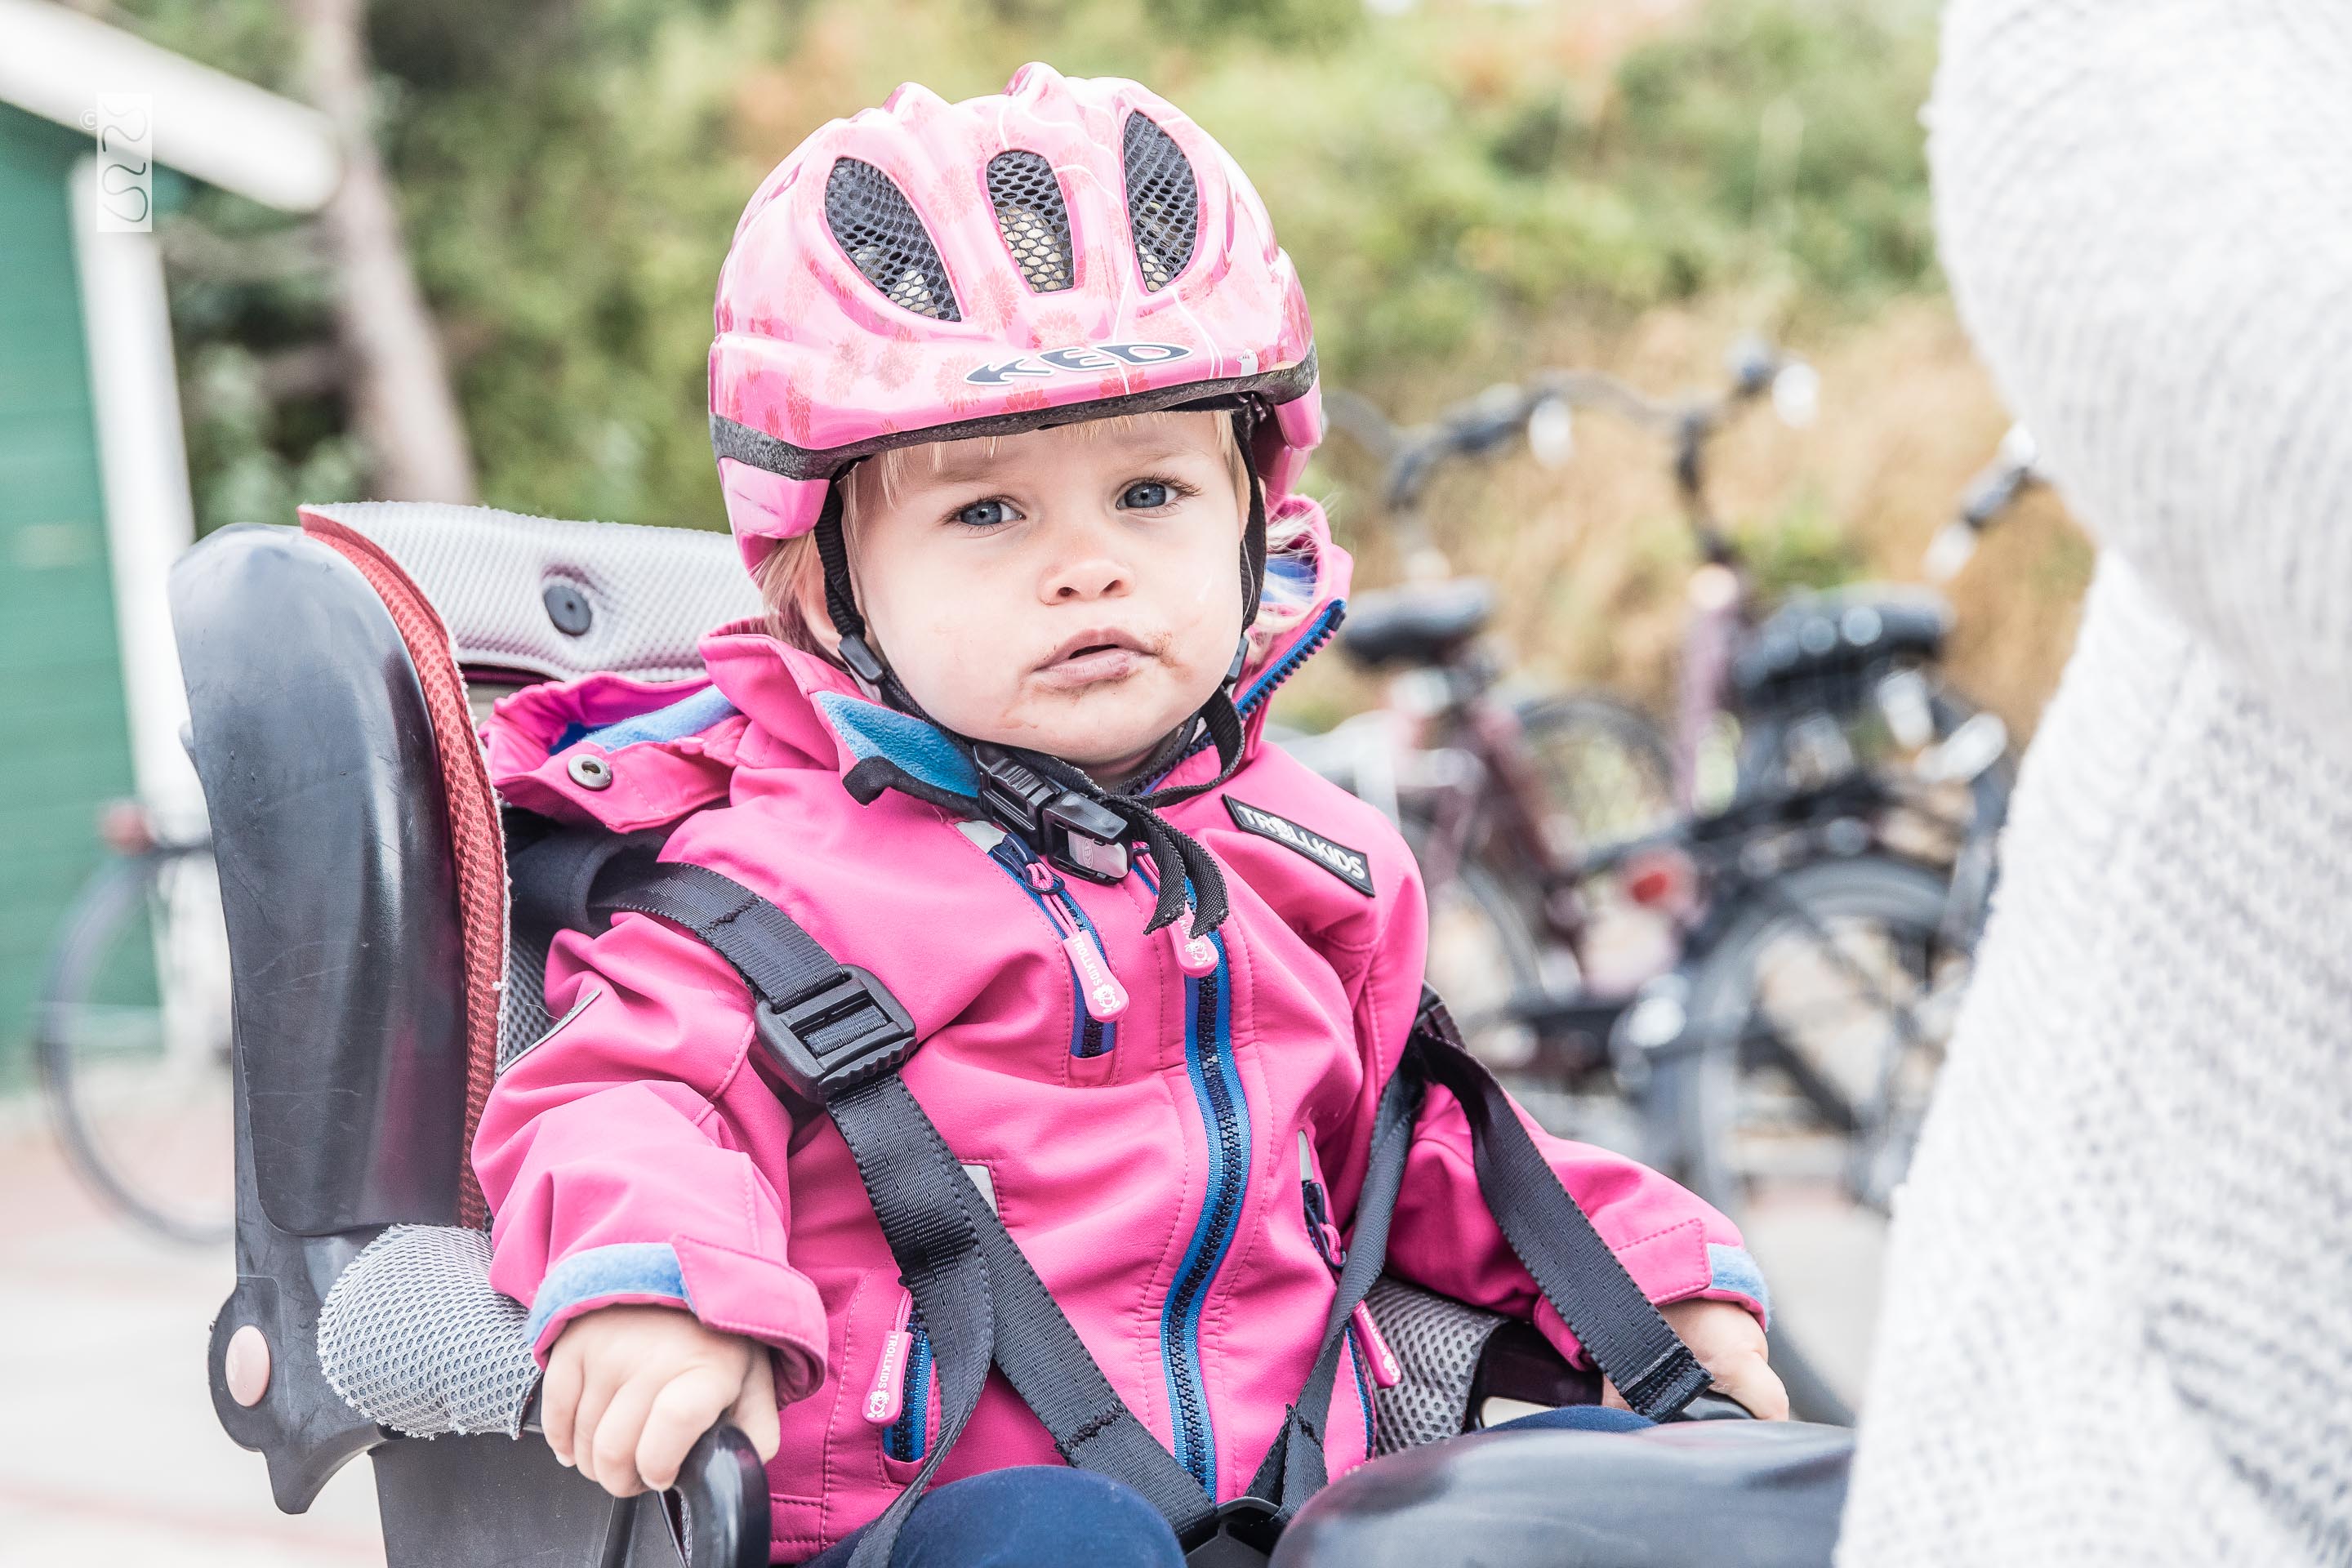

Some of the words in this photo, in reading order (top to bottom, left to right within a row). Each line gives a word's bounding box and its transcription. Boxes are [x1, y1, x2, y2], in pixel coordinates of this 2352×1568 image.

[963, 343, 1192, 384] KED
[1236, 804, 1365, 880] TROLLKIDS
[1071, 934, 1102, 987] TROLLKIDS
[878, 1334, 899, 1388] TROLLKIDS
